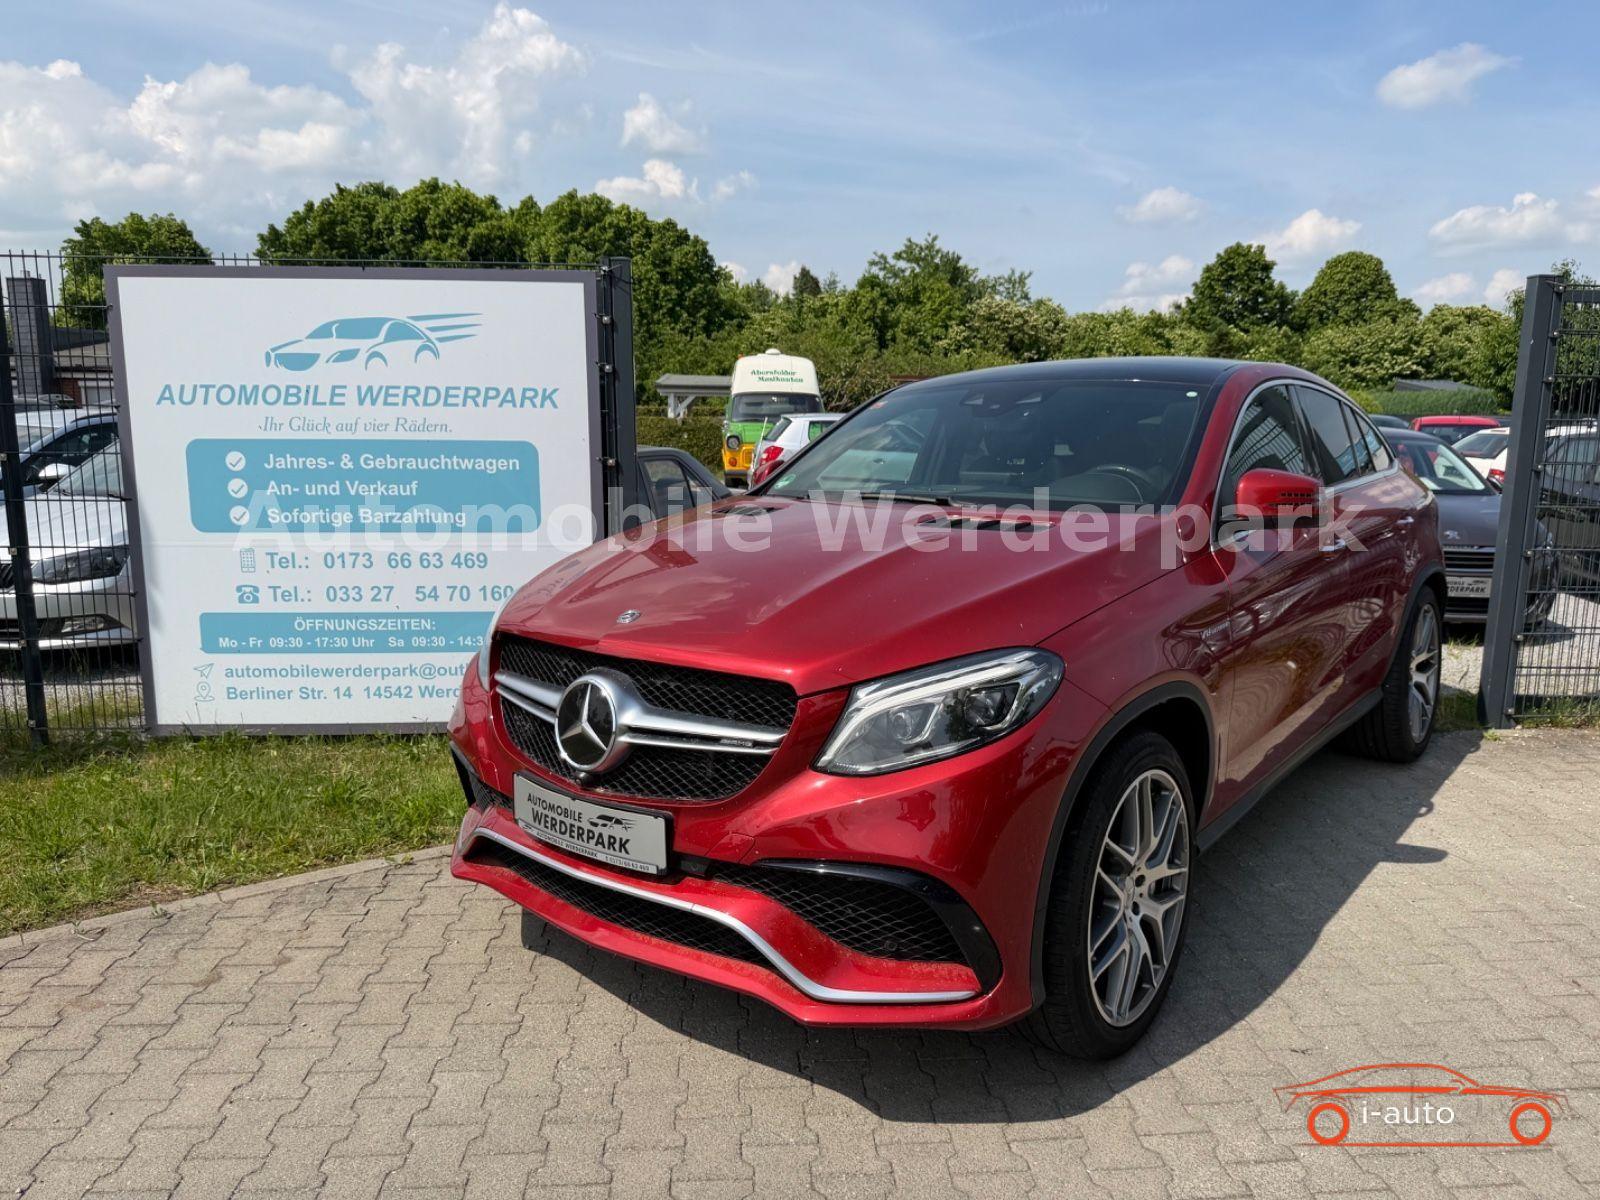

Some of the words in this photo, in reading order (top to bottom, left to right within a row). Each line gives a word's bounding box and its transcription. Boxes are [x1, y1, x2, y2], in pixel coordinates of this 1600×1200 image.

[156, 383, 347, 407] AUTOMOBILE
[356, 385, 559, 409] WERDERPARK
[258, 416, 284, 432] Ihr
[288, 415, 332, 435] Glück
[336, 416, 359, 435] auf
[364, 418, 389, 432] vier
[394, 417, 452, 433] Rädern.
[263, 453, 335, 470] Jahres-
[340, 453, 354, 470] &
[360, 453, 520, 474] Gebrauchtwagen
[266, 480, 300, 497] An-
[304, 480, 340, 496] und
[345, 480, 418, 496] Verkauf
[267, 507, 353, 528] Sofortige
[359, 507, 467, 527] Barzahlung
[266, 552, 310, 569] Tel.:
[323, 552, 374, 569] 0173
[387, 552, 412, 568] 66
[419, 552, 444, 568] 63
[451, 552, 488, 568] 469
[268, 586, 312, 602] Tel.:
[325, 586, 363, 602] 033
[370, 586, 394, 602] 27
[415, 585, 440, 602] 54
[446, 585, 471, 602] 70
[294, 616, 436, 631] ÖFFNUNGSZEITEN:
[219, 637, 239, 648] Mo
[249, 637, 263, 648] Fr
[269, 637, 303, 648] 09:30
[314, 637, 348, 648] 17:30
[352, 637, 375, 648] Uhr
[388, 637, 404, 648] Sa
[412, 636, 445, 648] 09:30
[457, 636, 484, 647] 14:3
[224, 663, 468, 680] automobilewerderpark@out
[226, 685, 294, 700] Berliner
[299, 685, 328, 700] Str.
[333, 685, 353, 700] 14
[364, 684, 413, 699] 14542
[527, 793, 583, 823] AUTOMOBILE
[532, 808, 631, 855] WERDERPARK
